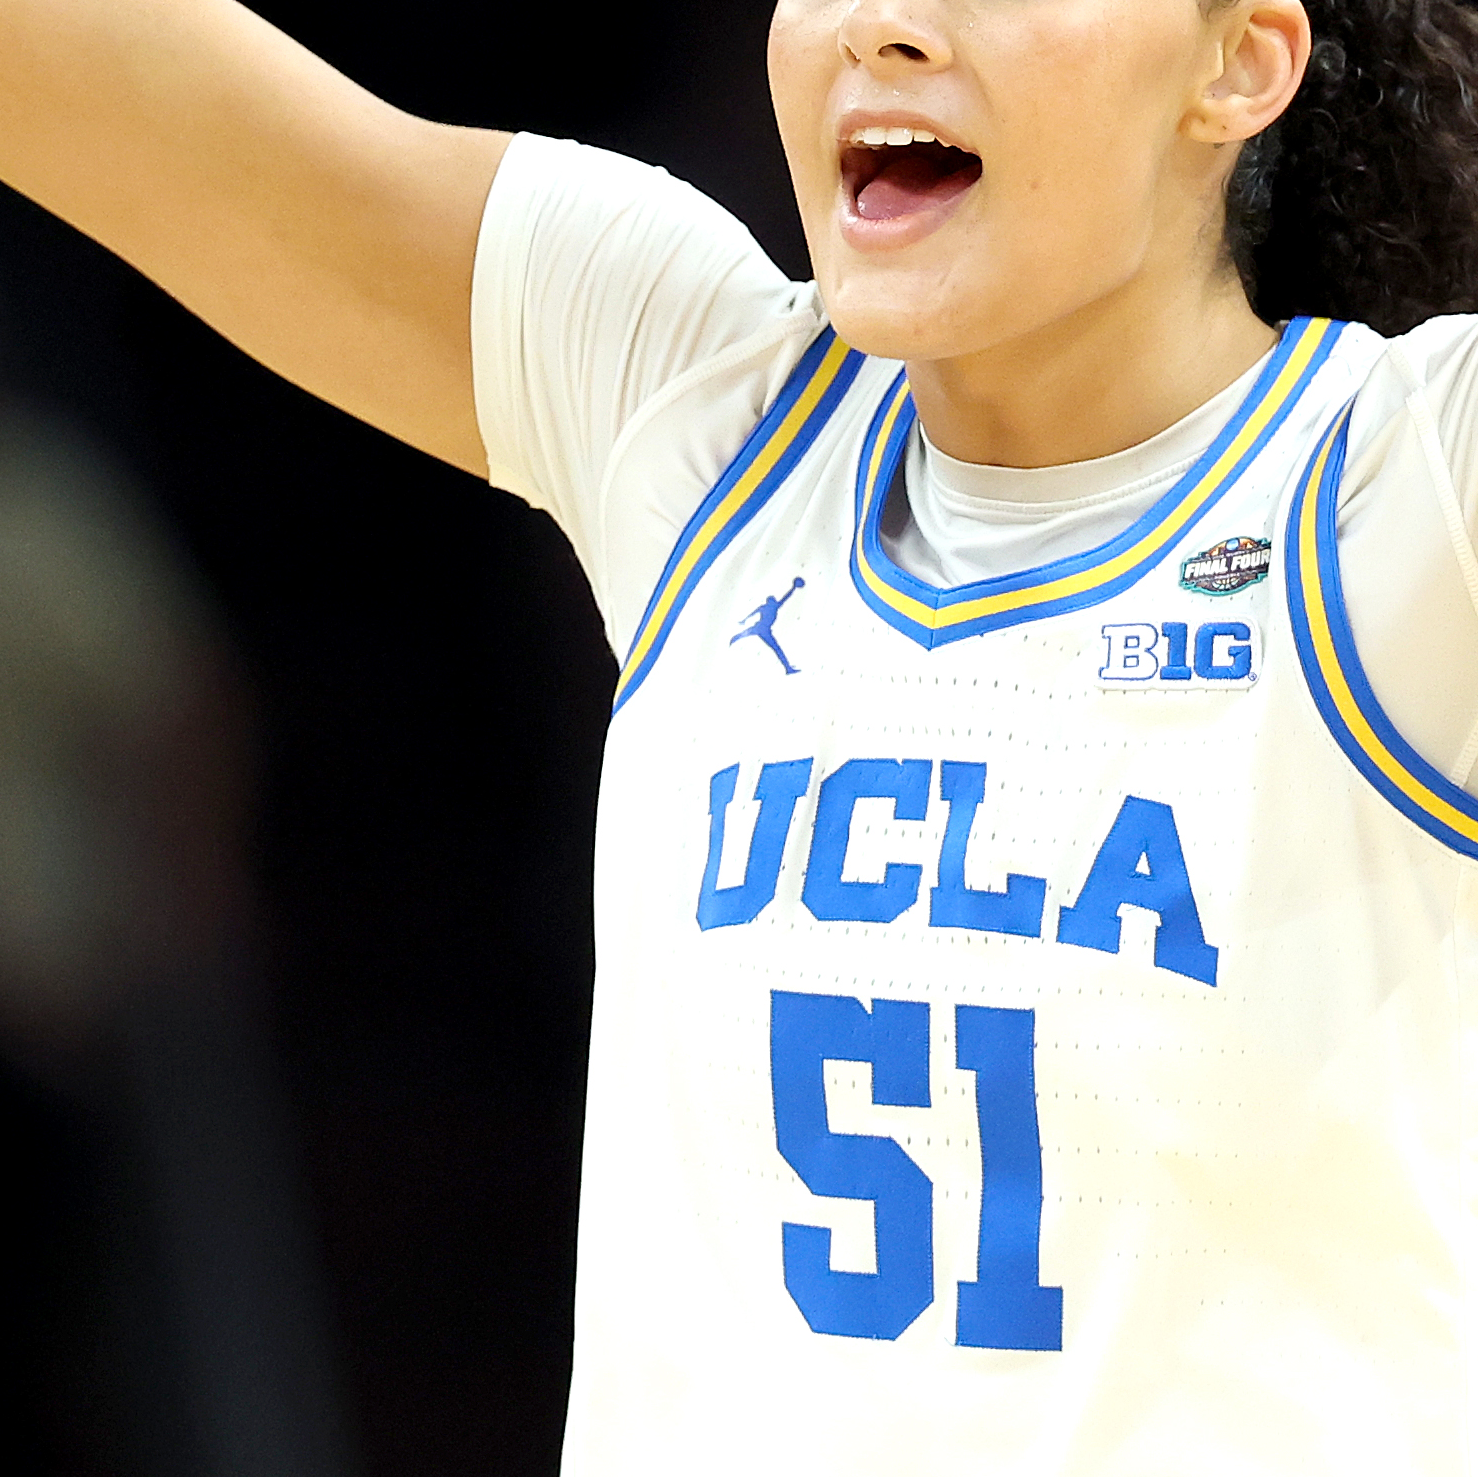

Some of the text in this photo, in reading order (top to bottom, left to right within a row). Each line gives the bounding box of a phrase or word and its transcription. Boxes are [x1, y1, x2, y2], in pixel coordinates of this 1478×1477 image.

[1184, 549, 1271, 578] FINAL FOUR
[696, 756, 1219, 987] UCLA
[770, 989, 1064, 1351] 51
